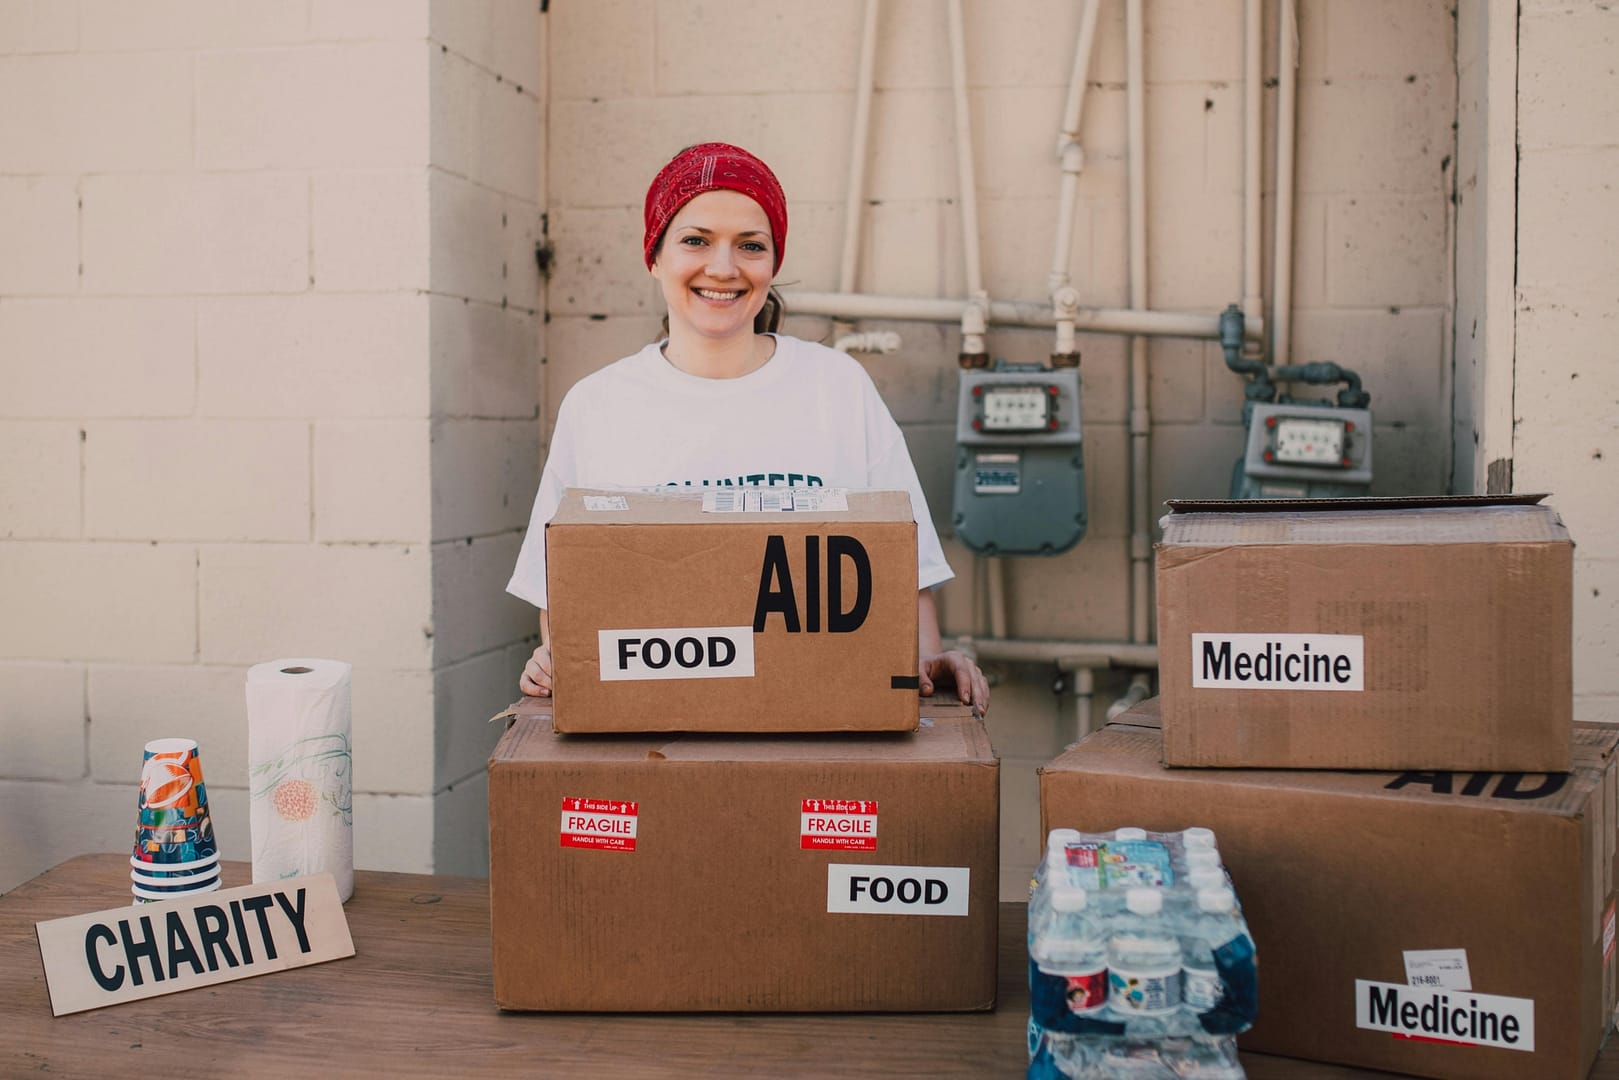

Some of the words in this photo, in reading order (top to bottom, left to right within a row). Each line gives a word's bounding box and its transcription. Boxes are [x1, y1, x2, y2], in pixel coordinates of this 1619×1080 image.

[753, 535, 873, 633] AID
[617, 637, 737, 670] FOOD
[1203, 641, 1352, 683] Medicine
[568, 816, 631, 834] FRAGILE
[808, 818, 871, 833] FRAGILE
[850, 876, 948, 905] FOOD
[85, 888, 312, 992] CHARITY
[1369, 986, 1520, 1044] Medicine
